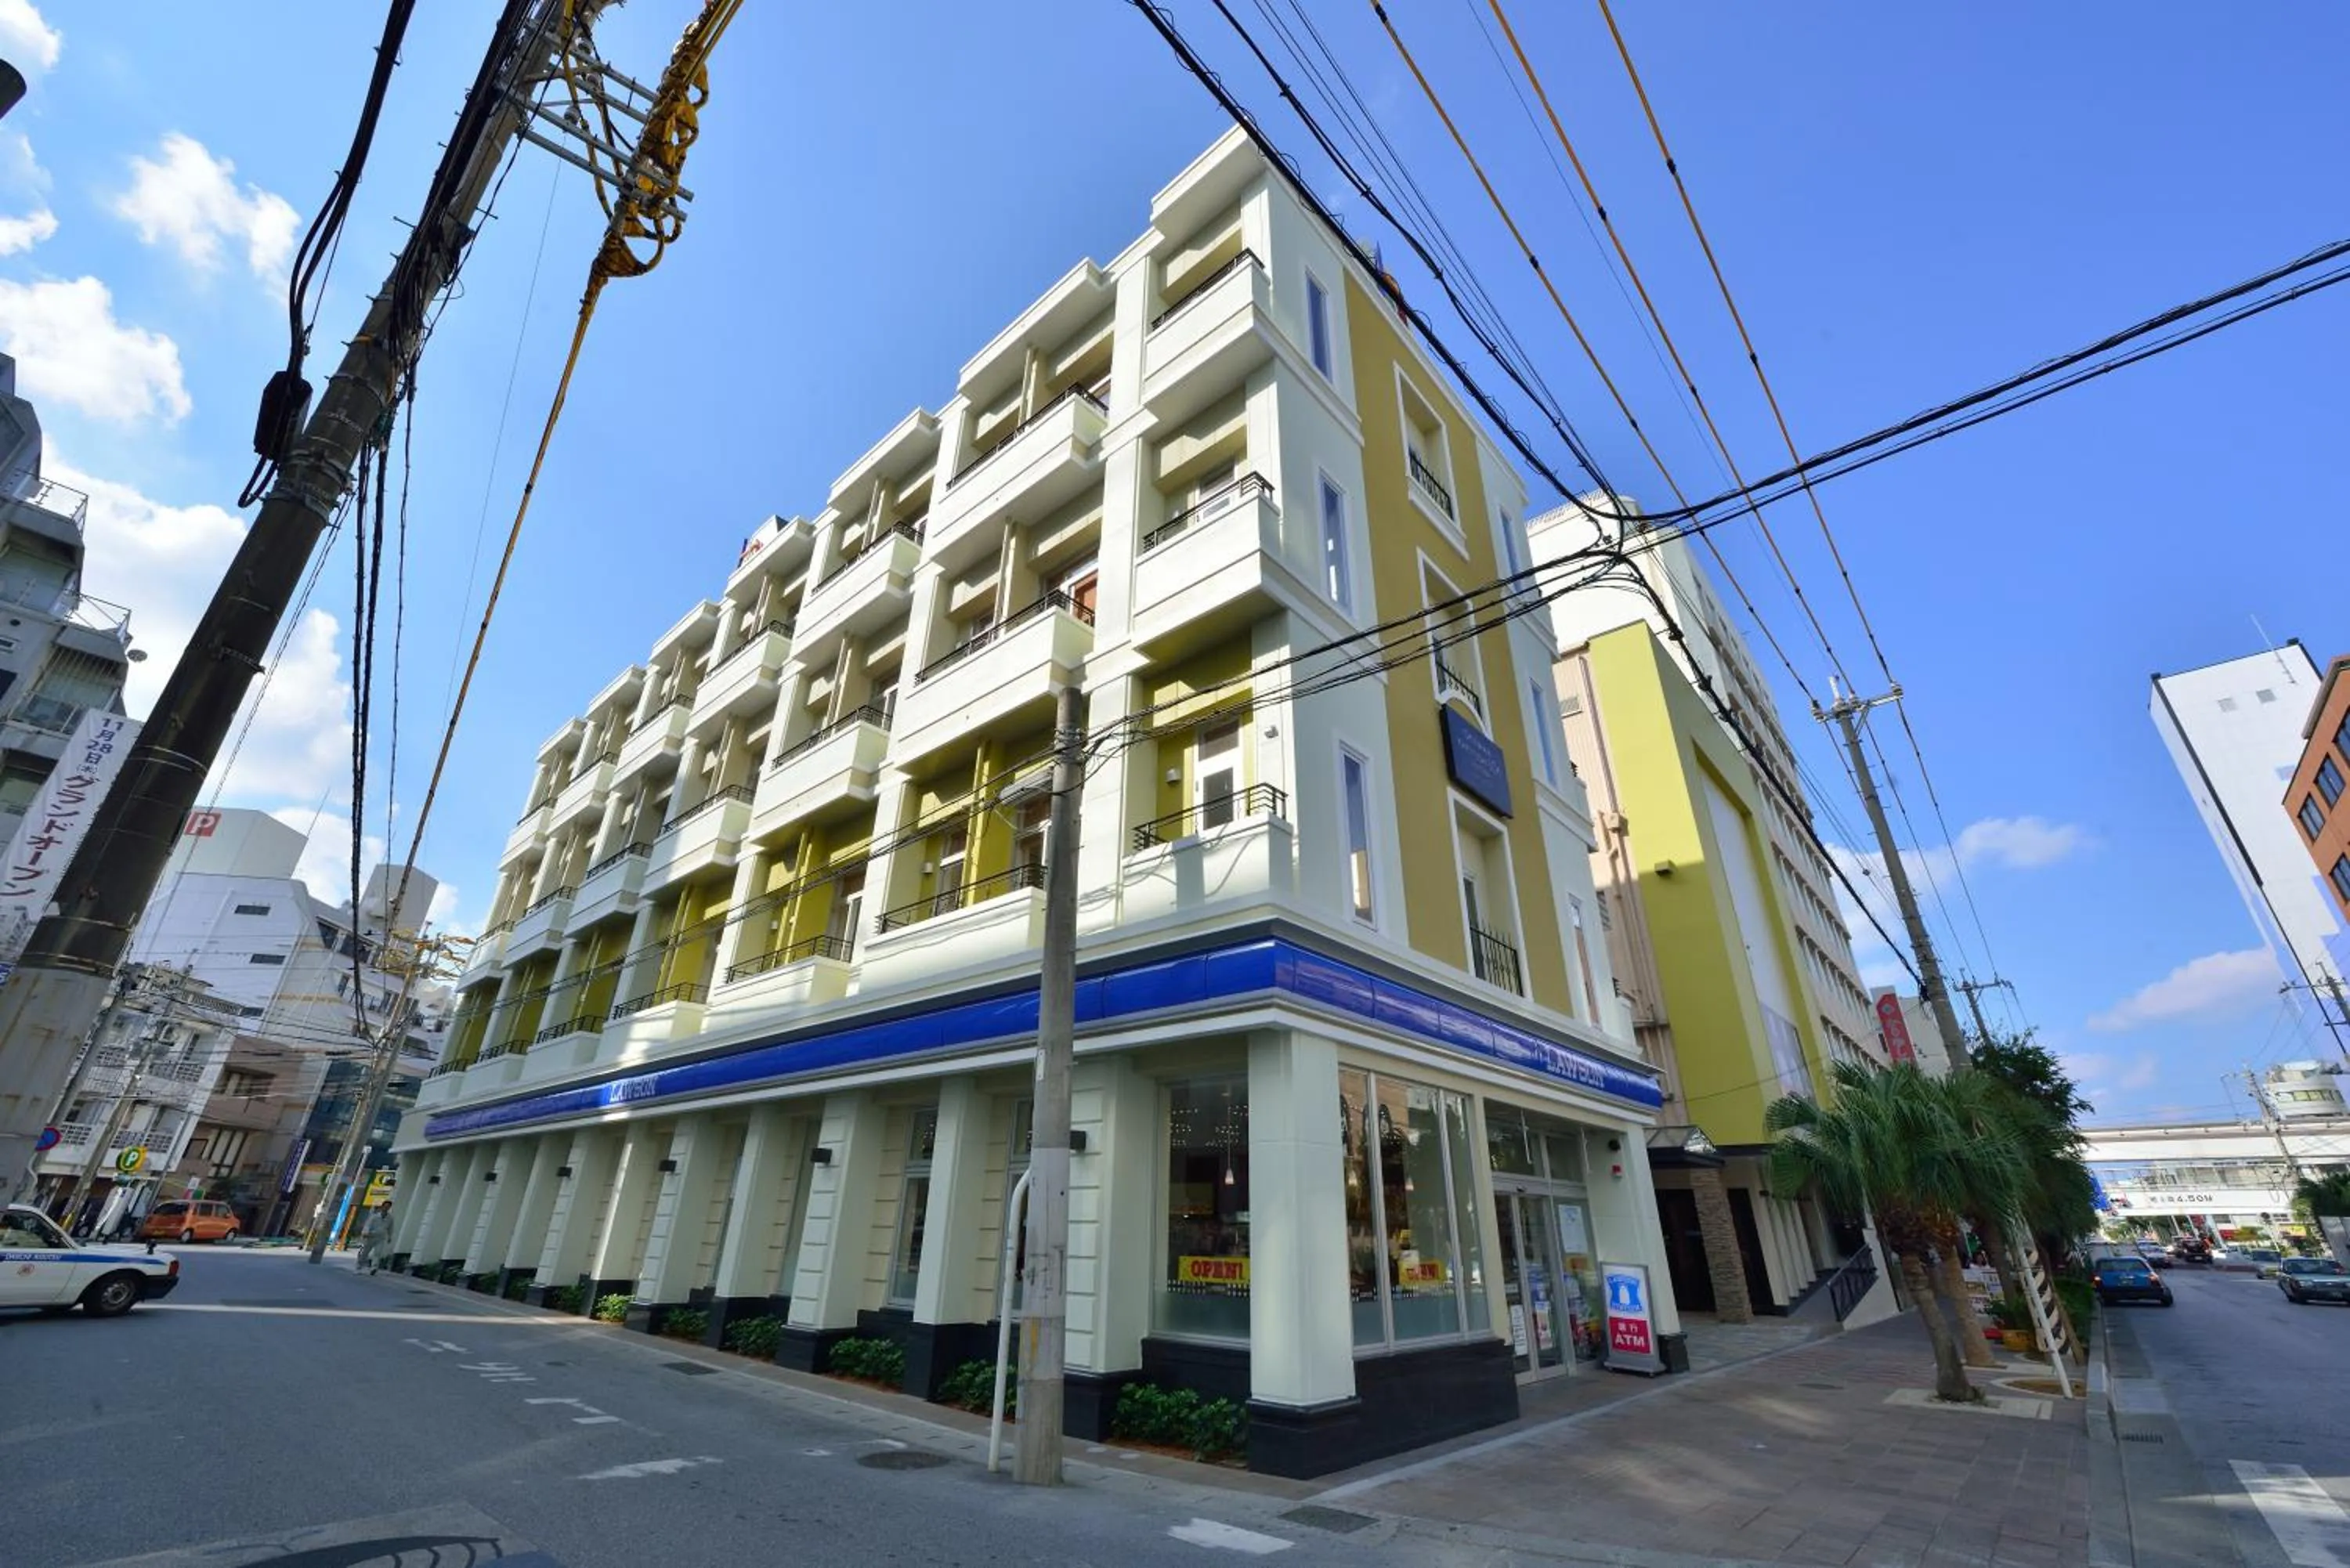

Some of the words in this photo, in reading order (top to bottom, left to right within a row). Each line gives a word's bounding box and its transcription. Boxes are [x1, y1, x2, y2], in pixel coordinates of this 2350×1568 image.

[0, 775, 101, 896] グランドオープン
[190, 814, 215, 834] P
[1546, 1047, 1605, 1089] LAWSON
[1615, 1334, 1645, 1347] ATM
